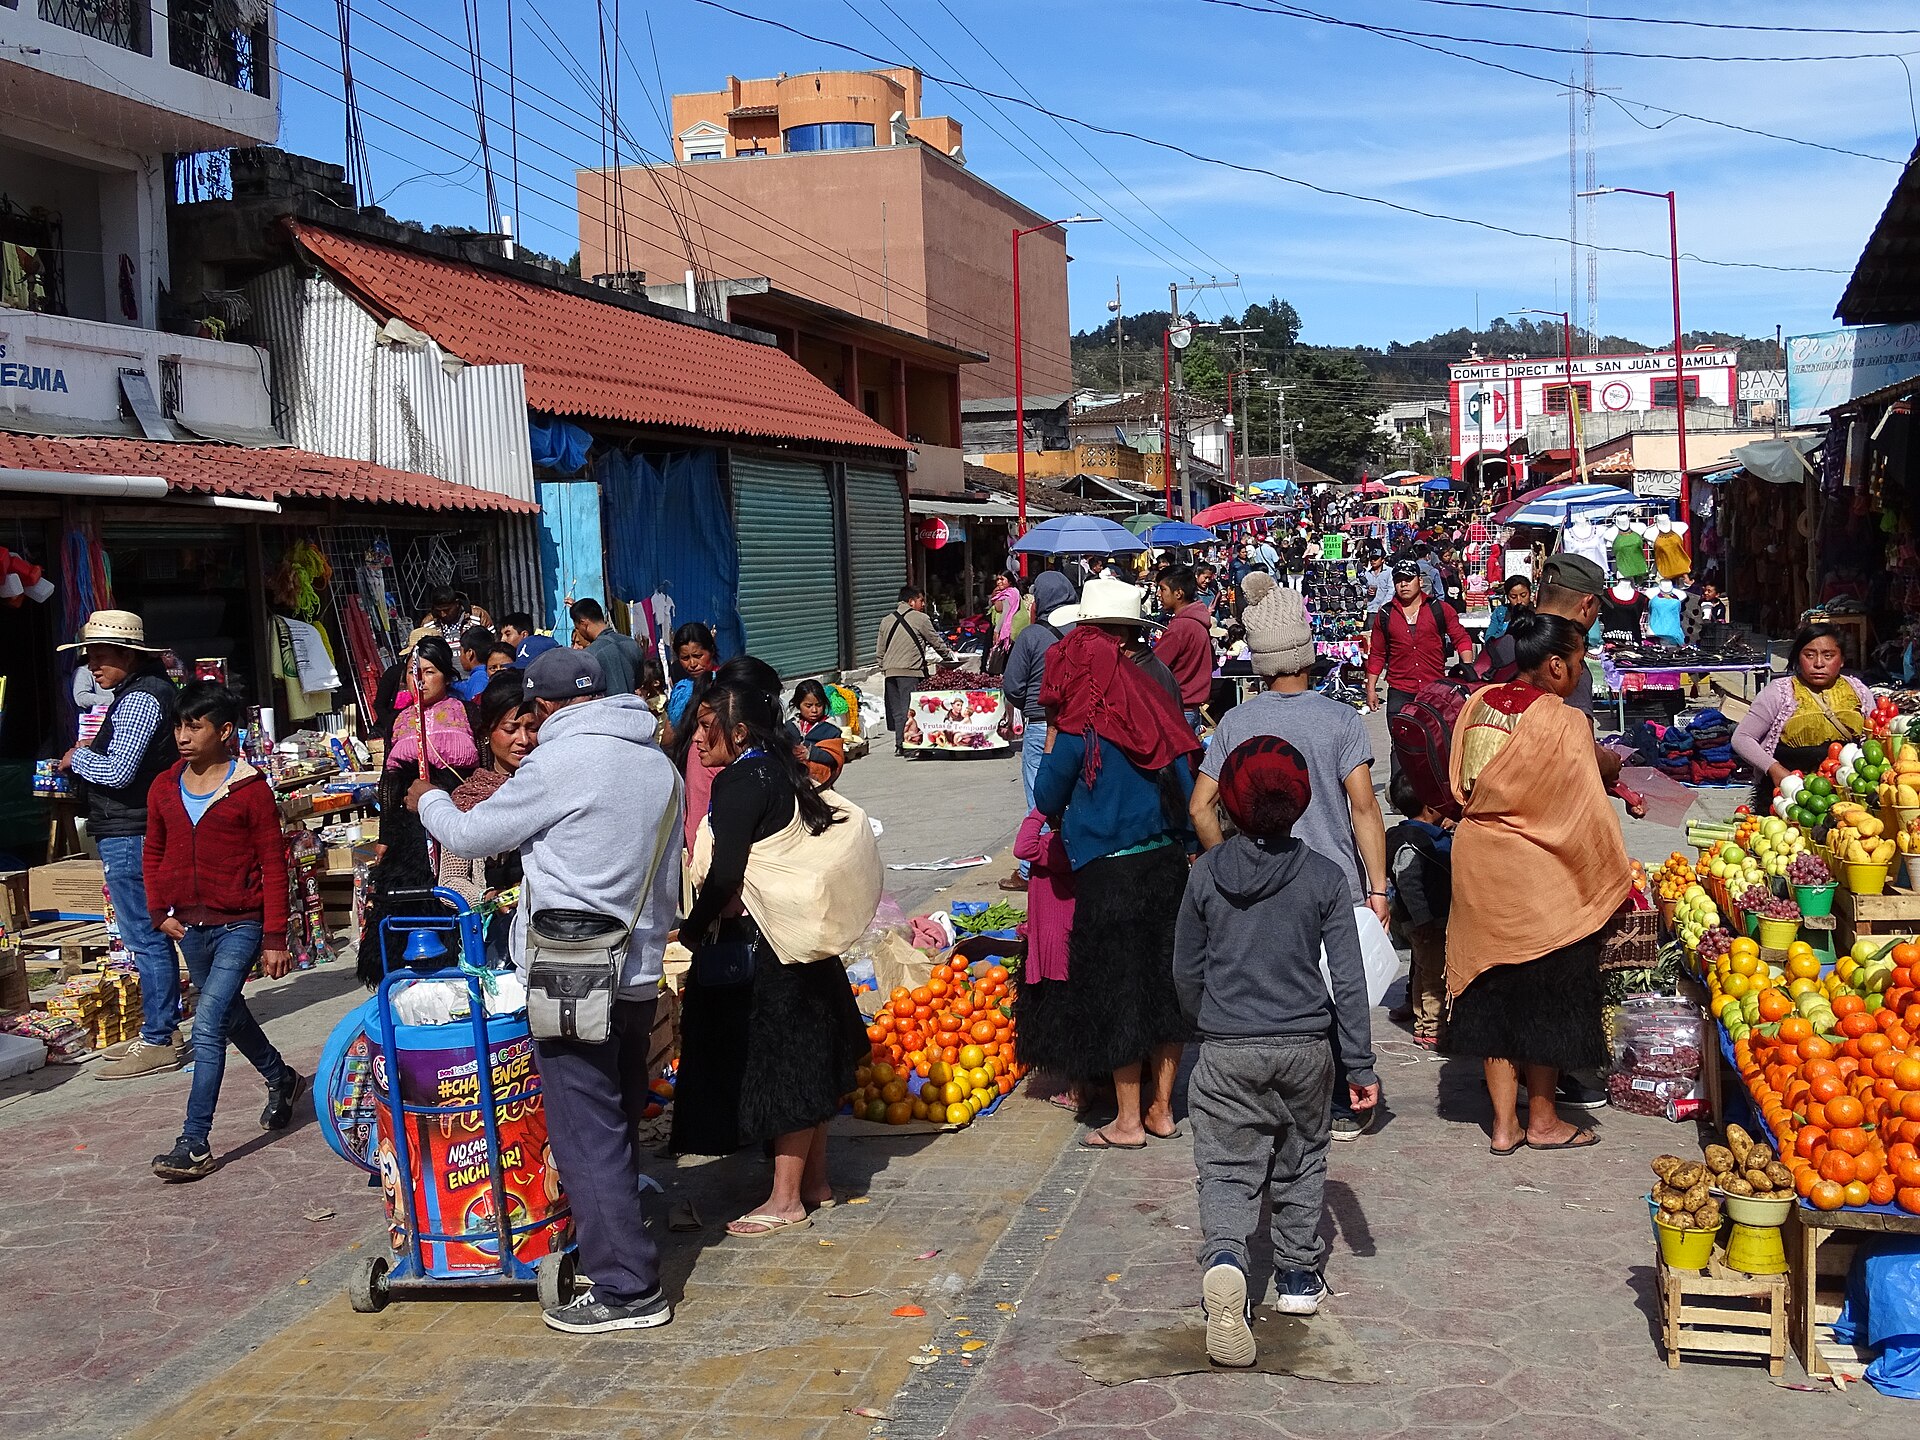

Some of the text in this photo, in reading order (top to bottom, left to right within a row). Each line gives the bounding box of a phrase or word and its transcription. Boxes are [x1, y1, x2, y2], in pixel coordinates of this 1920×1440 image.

[1454, 367, 1499, 379] COMITE
[1595, 361, 1621, 372] SAN
[1628, 359, 1660, 370] JUAN
[1668, 355, 1729, 368] CAMULA
[1740, 388, 1780, 398] SE RENTA
[1638, 484, 1654, 493] WC
[954, 723, 997, 732] Temporada
[438, 1053, 532, 1098] #CHAENGE
[467, 1138, 489, 1157] SAB
[448, 1146, 522, 1190] ENCHIR!
